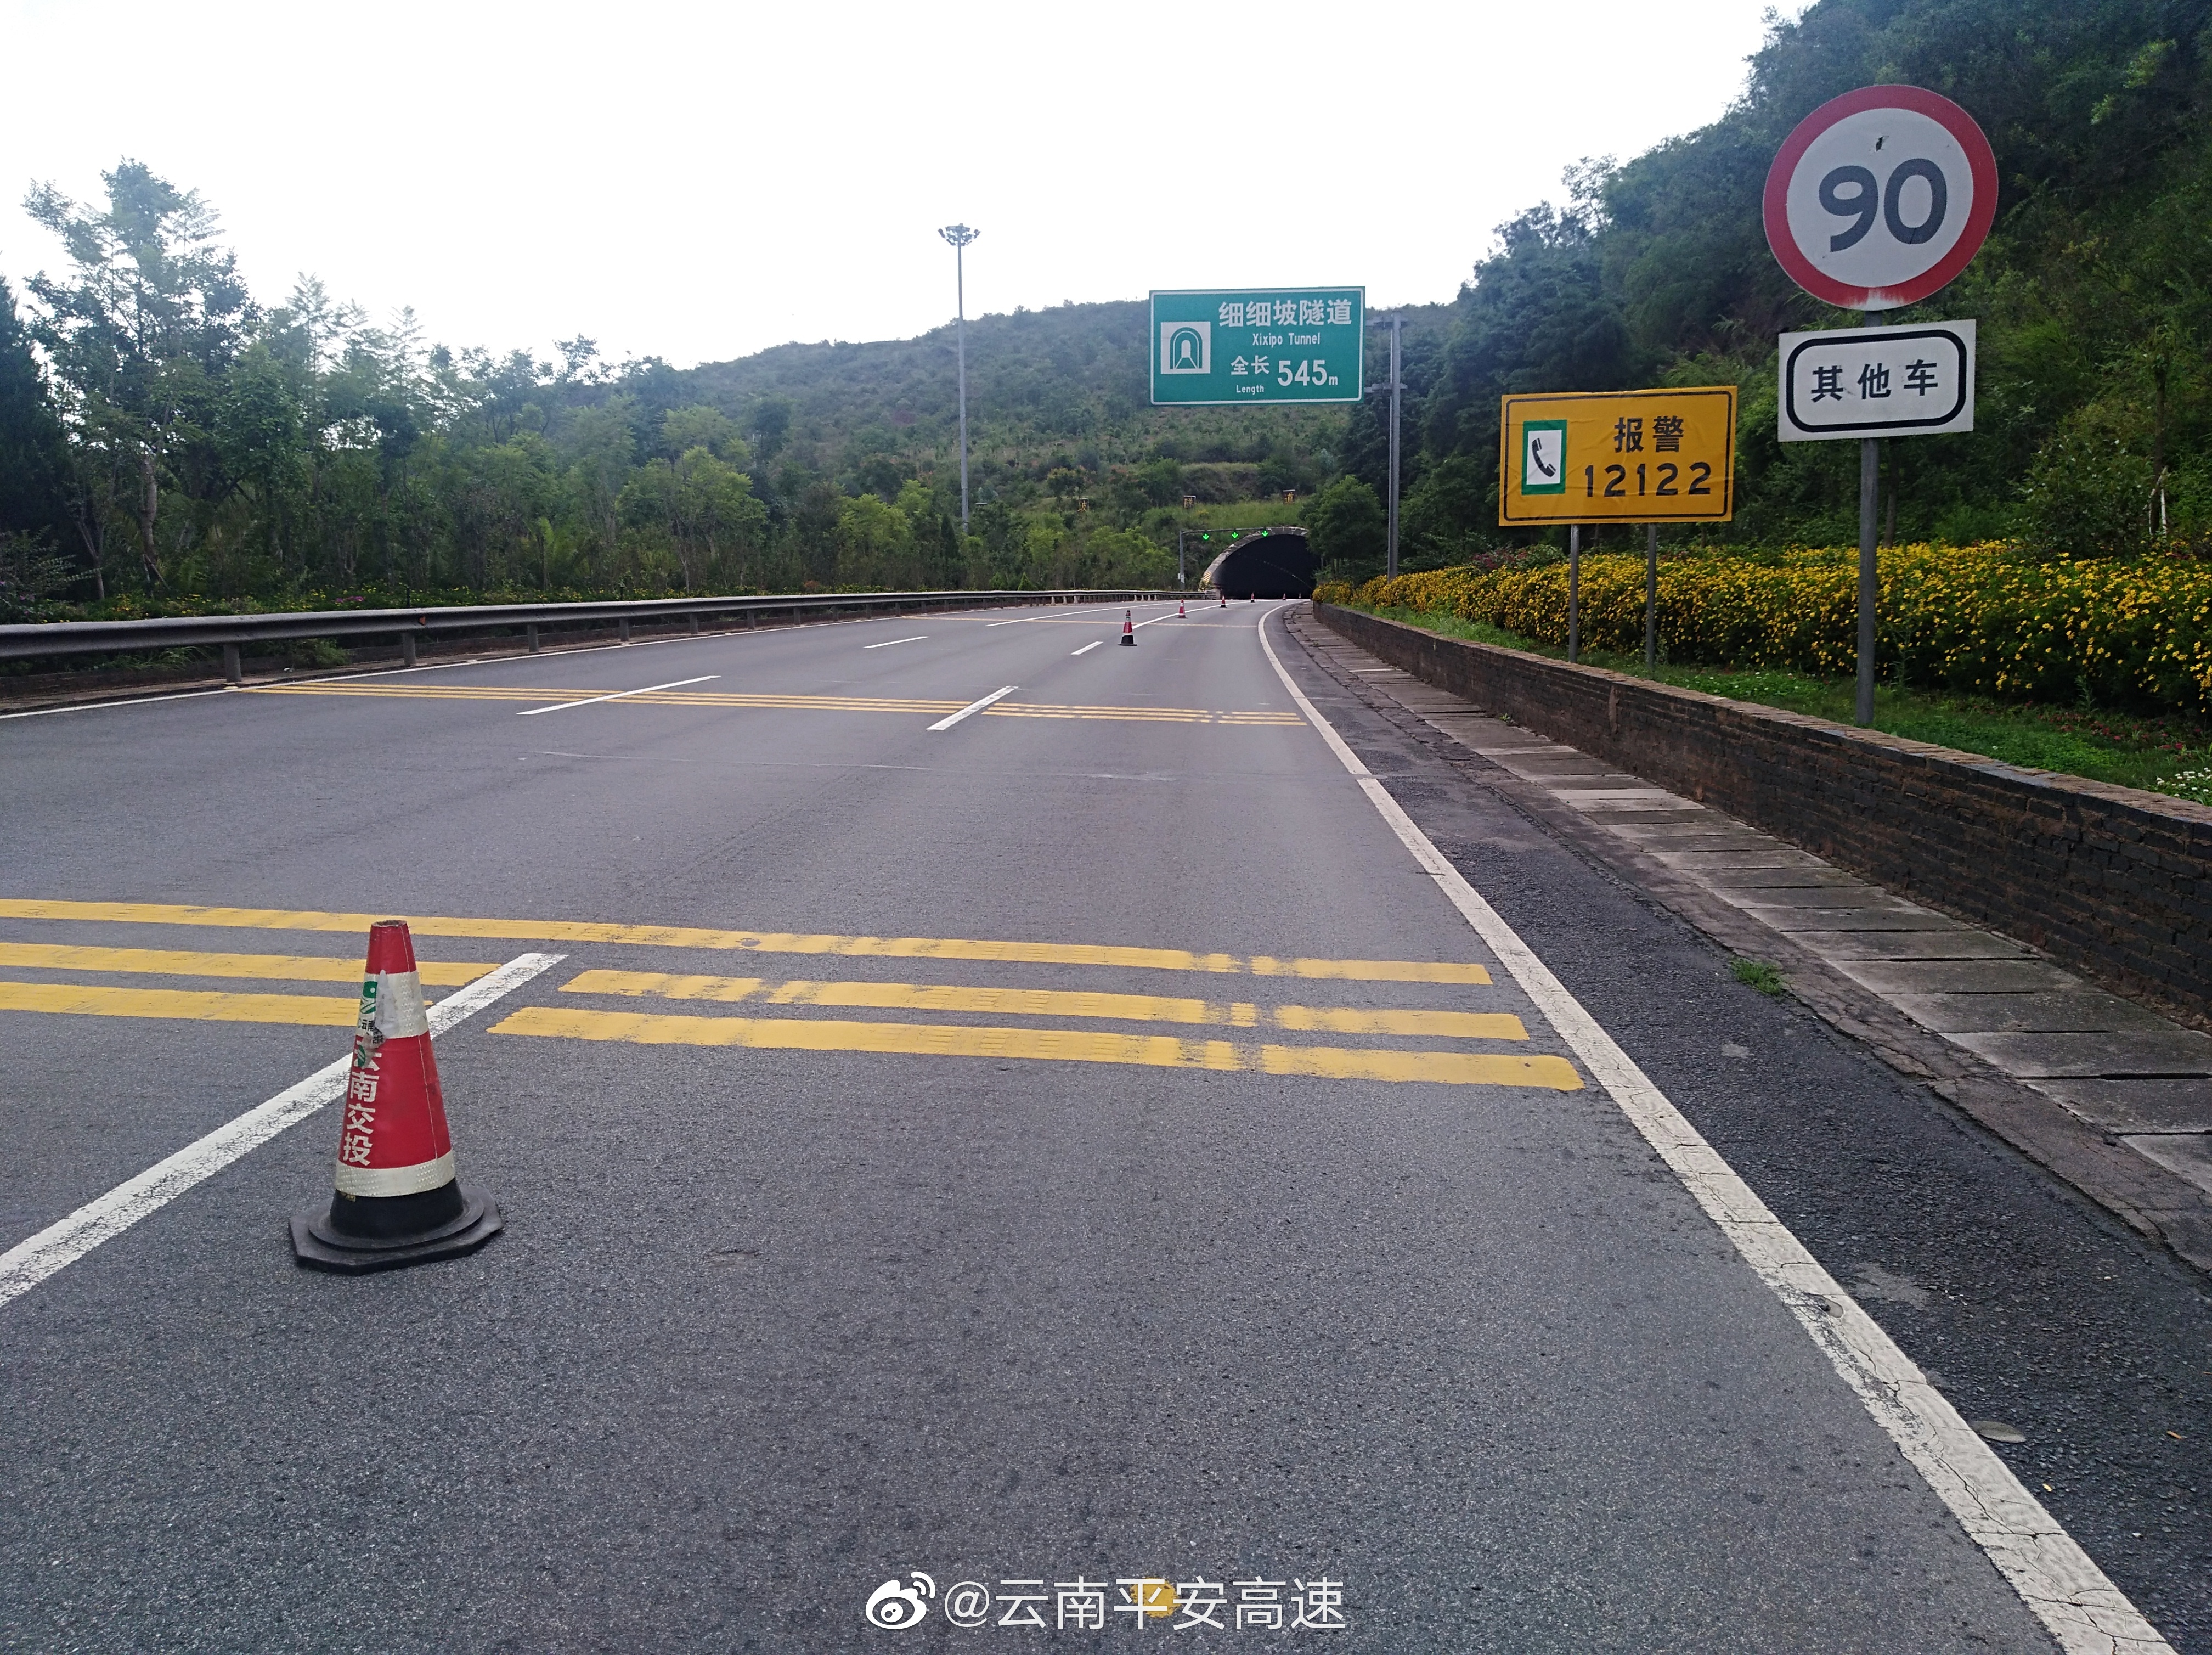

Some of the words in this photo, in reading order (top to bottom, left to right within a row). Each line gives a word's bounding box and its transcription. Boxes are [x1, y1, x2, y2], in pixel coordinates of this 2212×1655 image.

[1819, 158, 1947, 252] 90
[1218, 299, 1352, 327] 细细坡隧道
[1252, 333, 1283, 348] Xixipo
[1288, 333, 1321, 345] Tunnel
[1231, 355, 1270, 375] 全长
[1277, 359, 1338, 386] 545m
[1811, 359, 1938, 403] 其他车
[1236, 385, 1265, 395] Length
[1614, 415, 1684, 453] 报警
[1585, 461, 1711, 497] 12122
